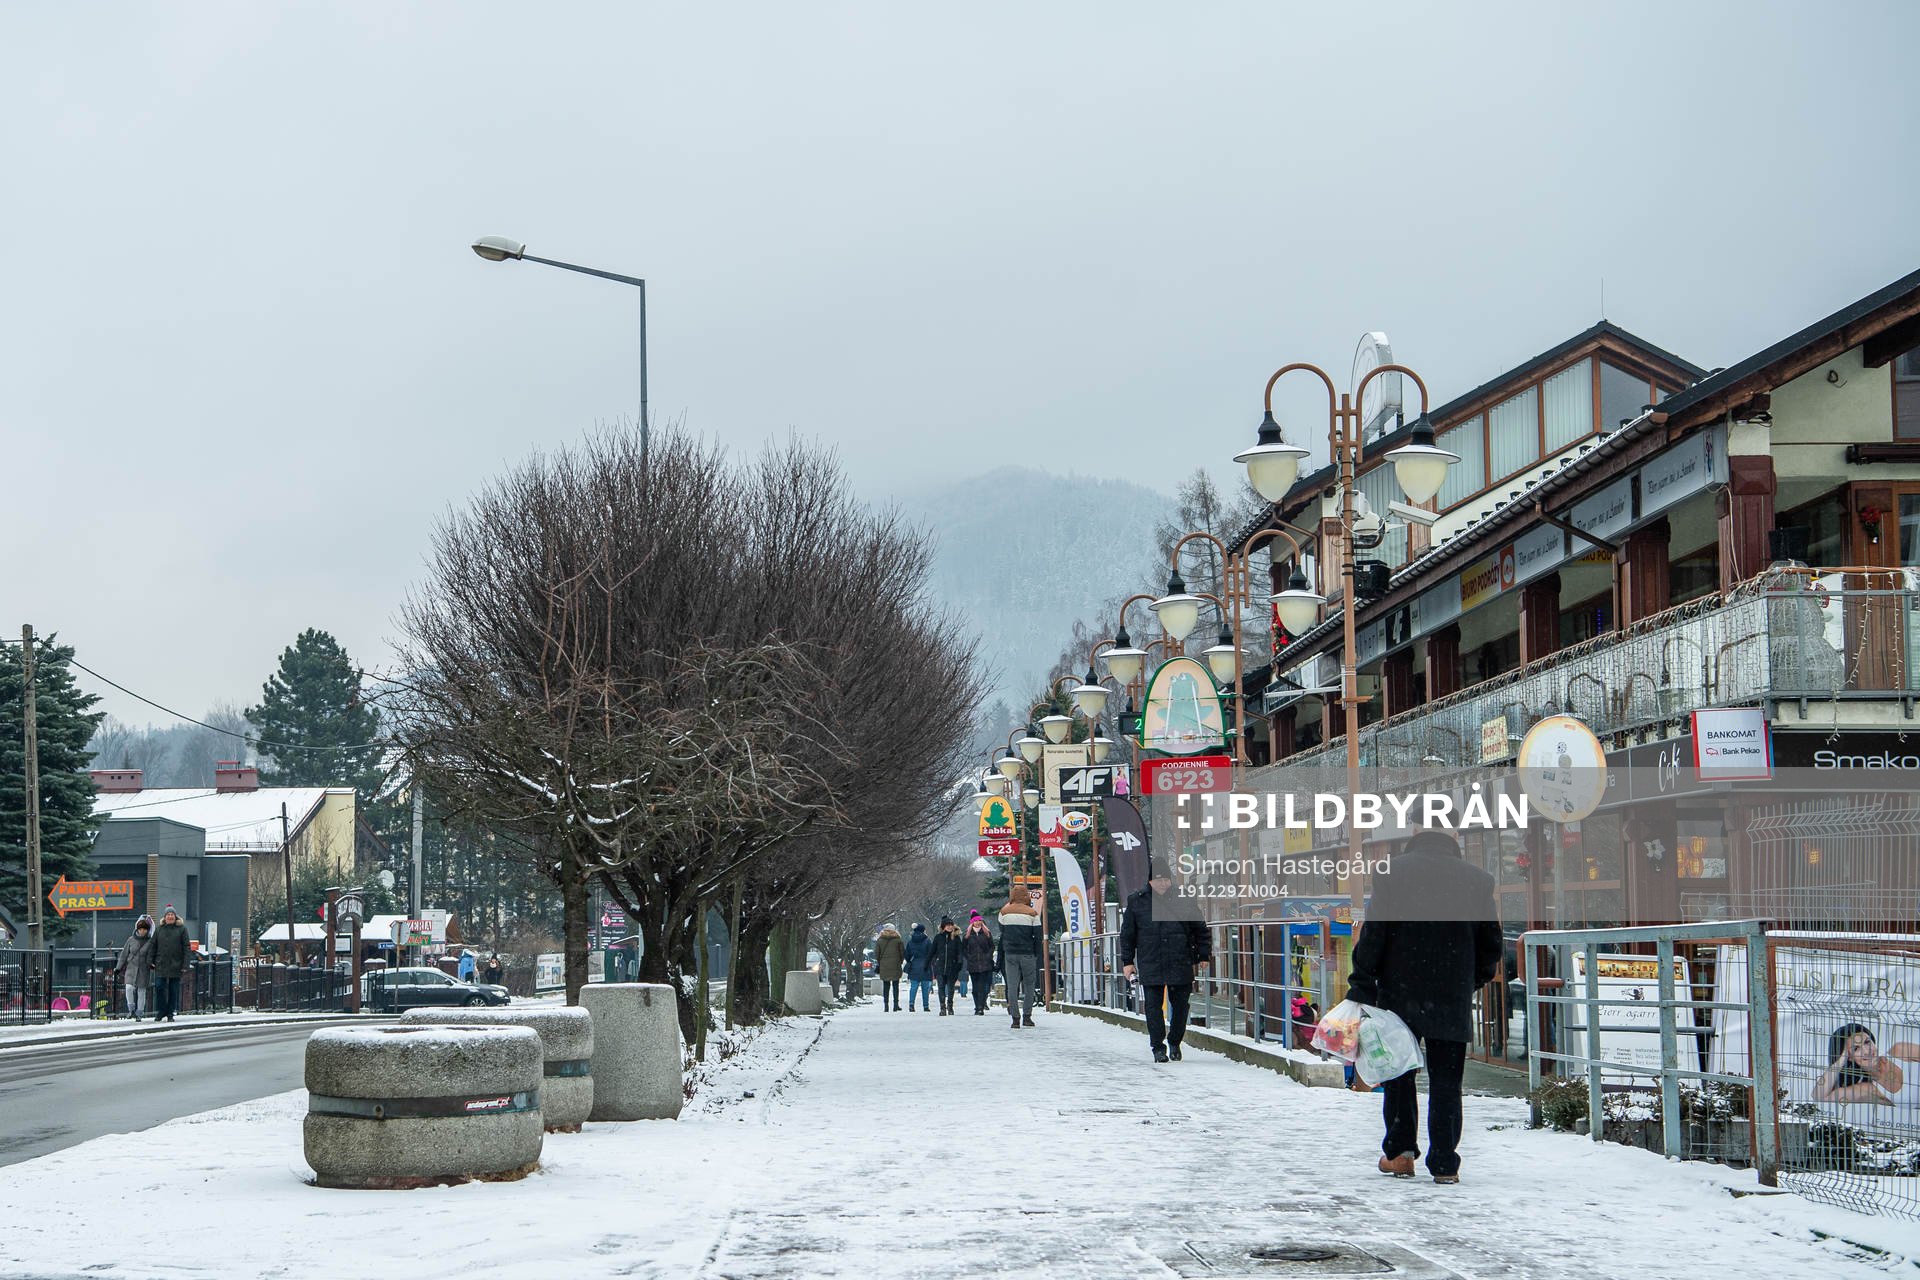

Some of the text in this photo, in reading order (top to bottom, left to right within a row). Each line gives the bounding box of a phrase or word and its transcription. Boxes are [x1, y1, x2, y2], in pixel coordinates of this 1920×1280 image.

[1707, 730, 1757, 740] BANKOMAT
[1722, 747, 1760, 755] Bank Pekao
[1161, 760, 1209, 769] CODZIENNIE
[1814, 750, 1920, 771] Smako
[1658, 742, 1682, 792] Café
[1062, 768, 1110, 794] 4F
[983, 826, 1012, 835] żabka
[986, 845, 1013, 855] 6-23
[59, 883, 127, 897] PAMIĄTKI
[59, 897, 107, 909] PRASA
